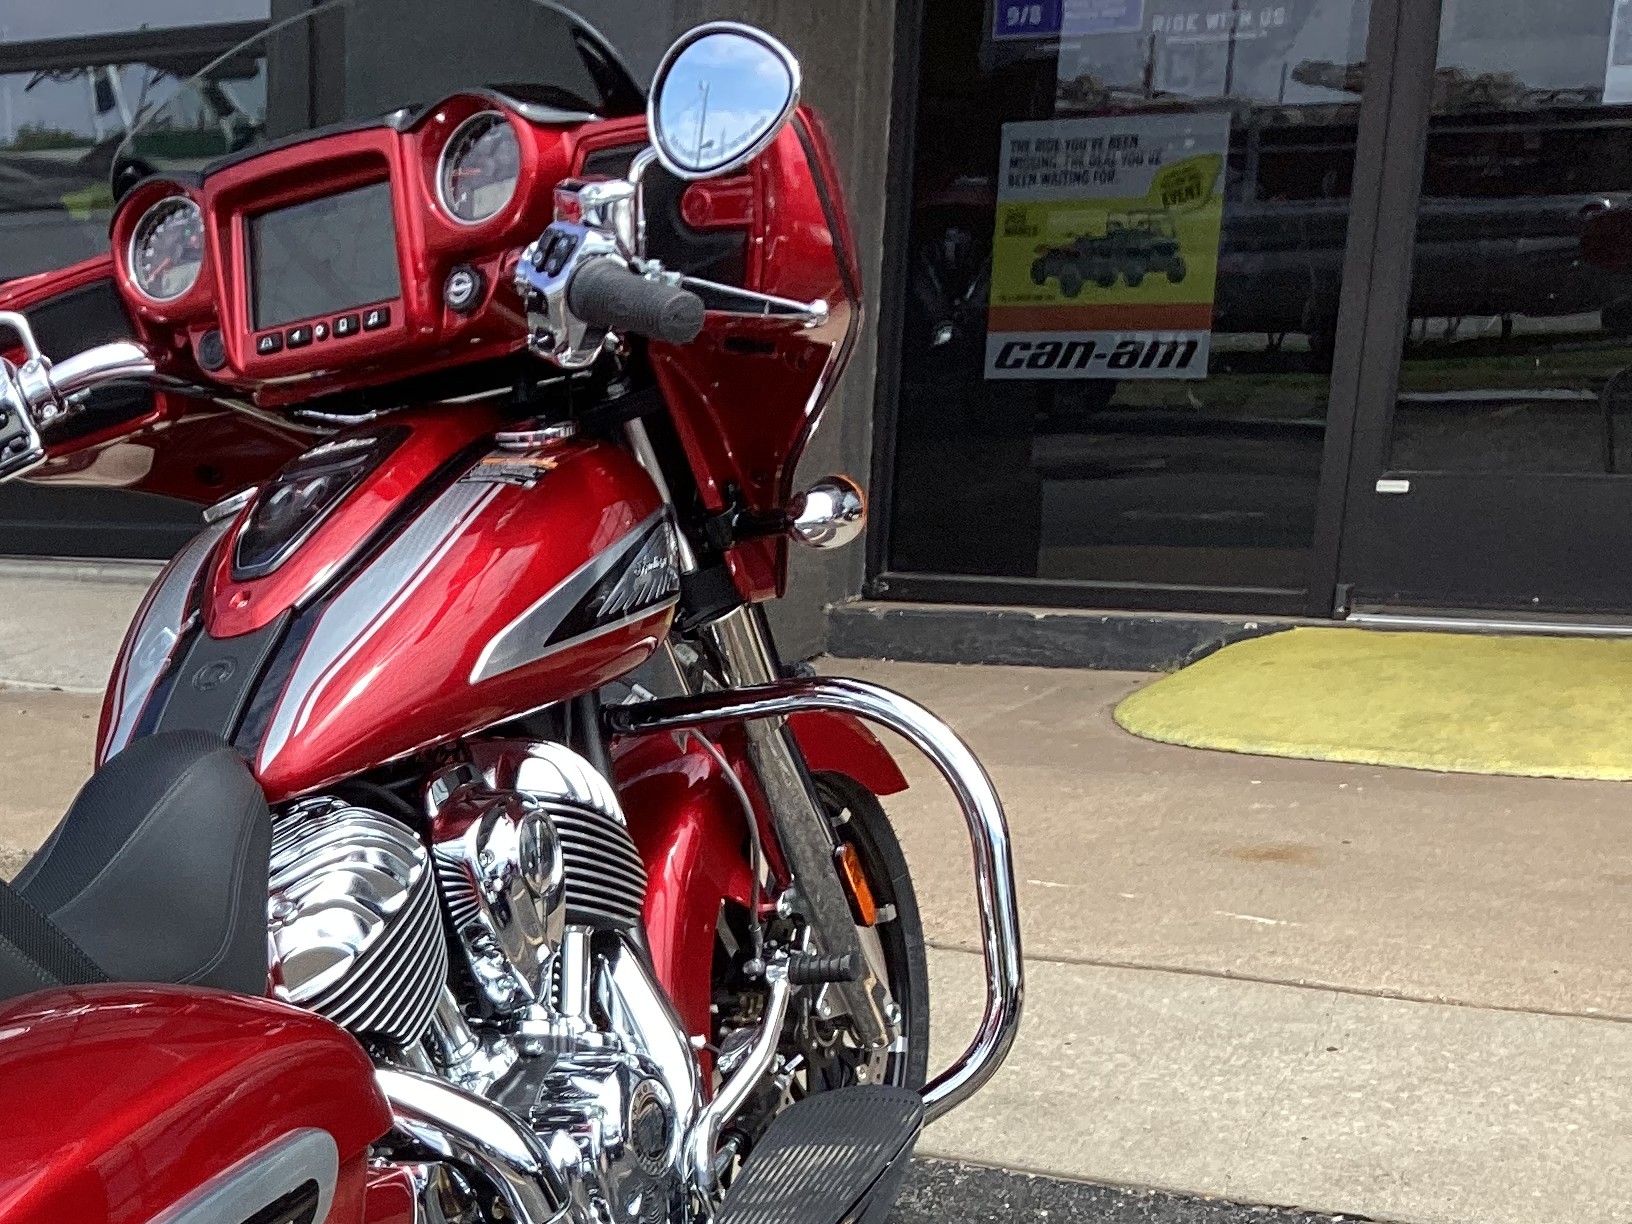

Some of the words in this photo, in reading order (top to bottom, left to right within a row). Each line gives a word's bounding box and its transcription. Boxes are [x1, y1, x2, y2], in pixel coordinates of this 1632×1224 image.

[1152, 13, 1200, 32] RIDE
[1259, 7, 1286, 27] US
[1108, 133, 1139, 150] BEEN
[1008, 172, 1037, 187] BEEN
[1040, 169, 1090, 187] WAITING
[994, 339, 1198, 369] can-am
